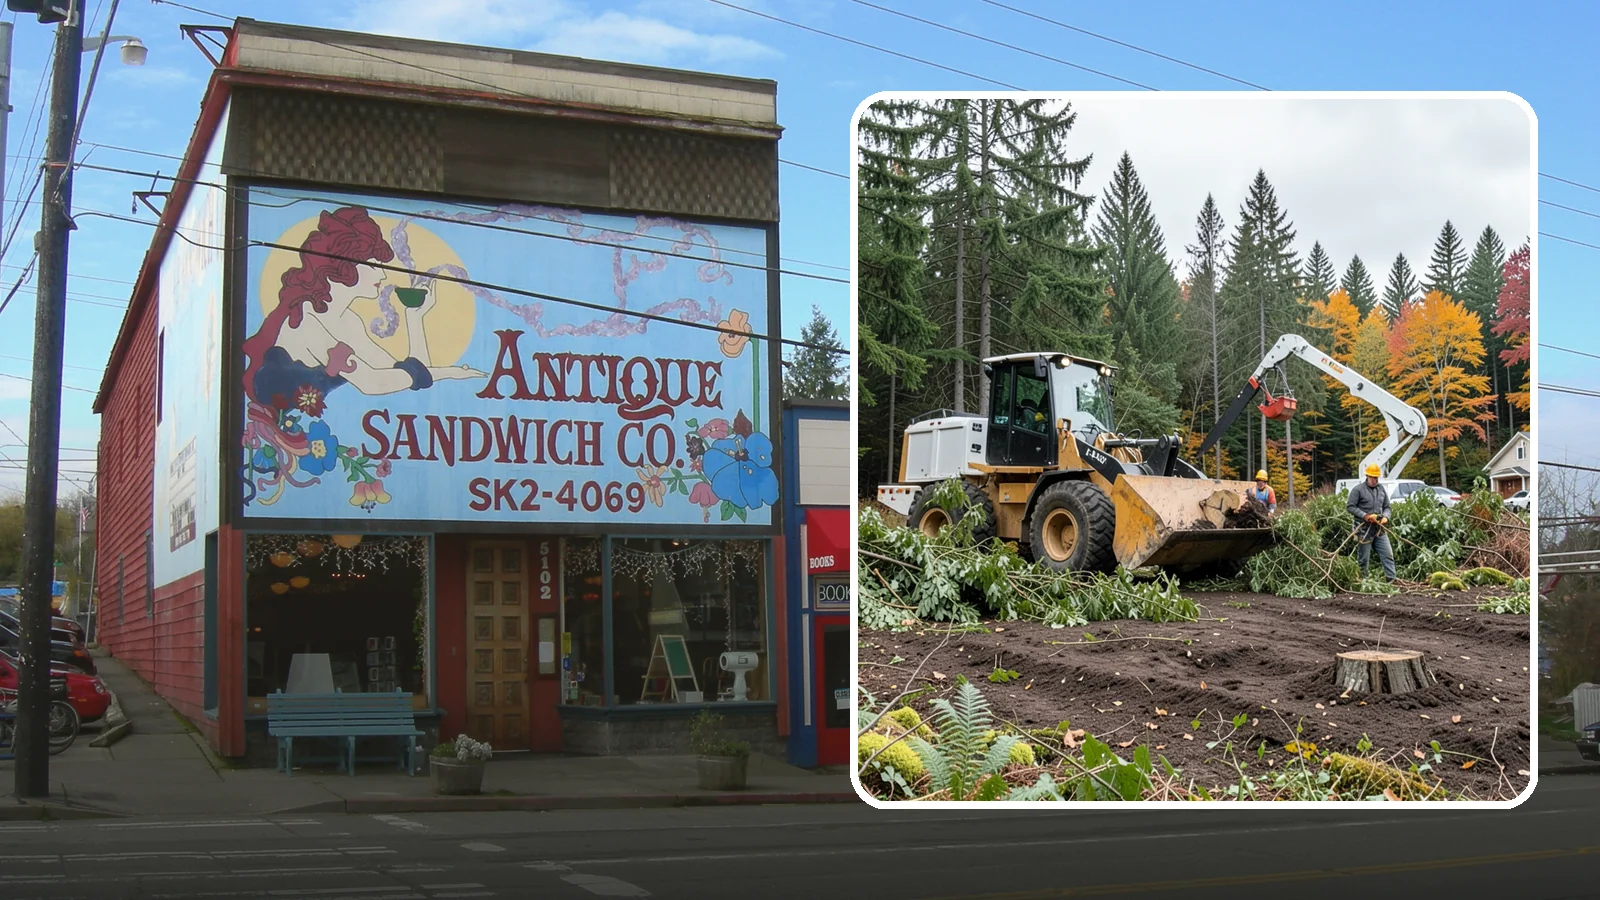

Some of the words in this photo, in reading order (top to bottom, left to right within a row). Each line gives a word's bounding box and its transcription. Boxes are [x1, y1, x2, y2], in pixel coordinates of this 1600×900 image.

[476, 329, 723, 421] ANTIQUE
[361, 408, 604, 468] SANDWICH
[618, 422, 685, 469] CO.
[468, 477, 646, 513] SK2-4069
[809, 555, 835, 568] BOOKS
